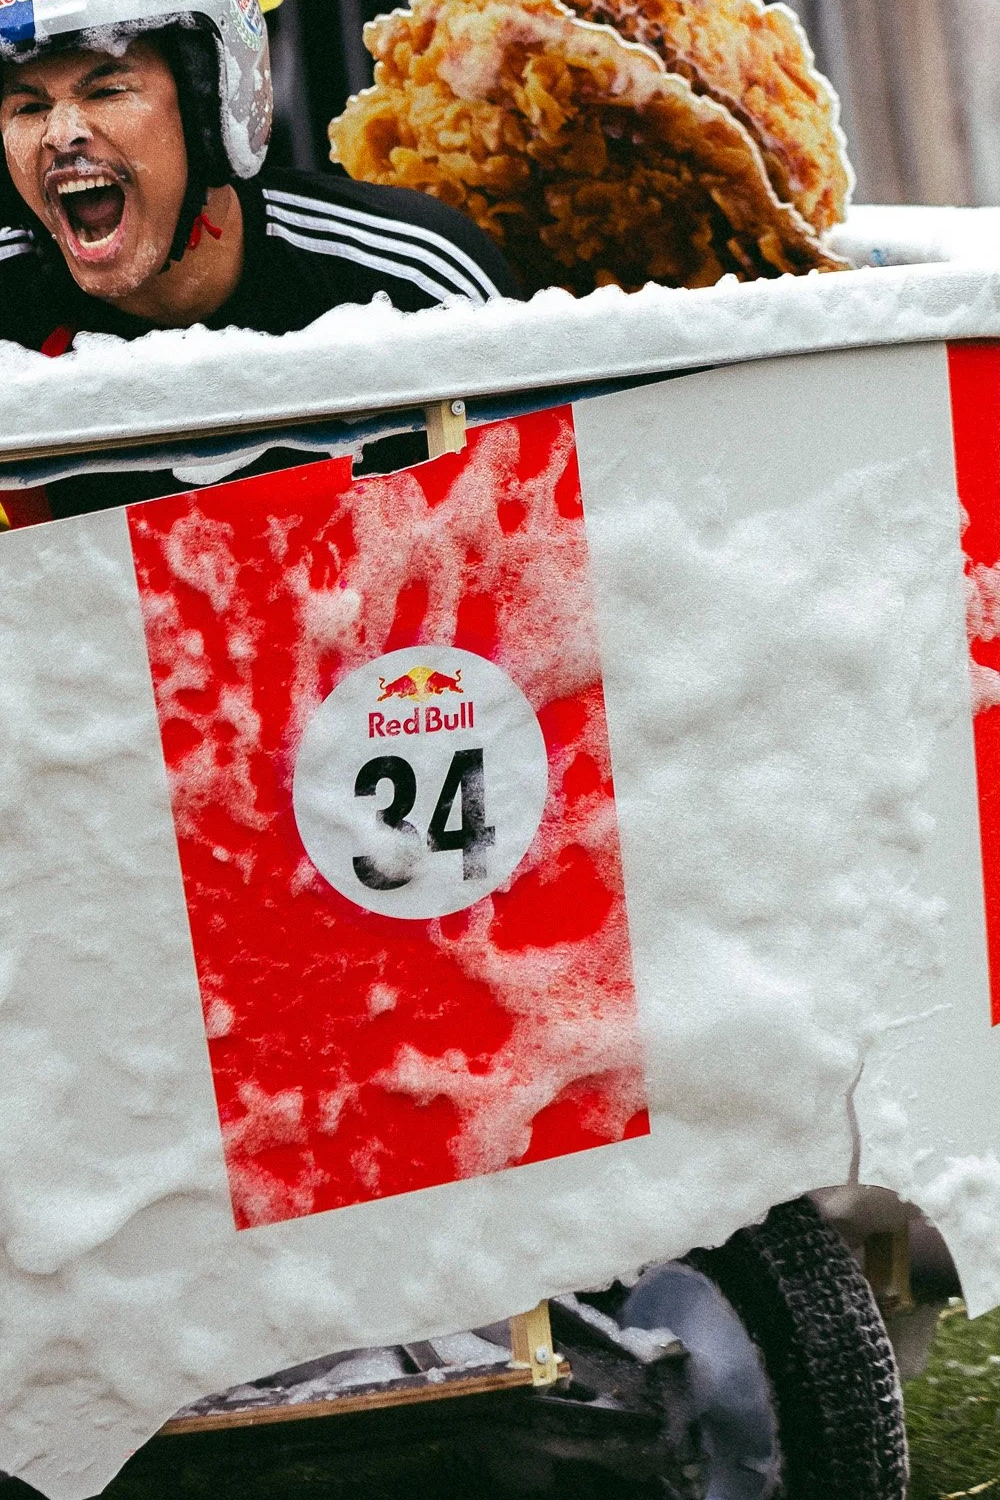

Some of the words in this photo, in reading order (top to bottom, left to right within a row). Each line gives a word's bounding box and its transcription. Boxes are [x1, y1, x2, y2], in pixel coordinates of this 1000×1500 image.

[367, 706, 420, 738] Red
[425, 702, 475, 733] Bull
[352, 748, 496, 891] 34
